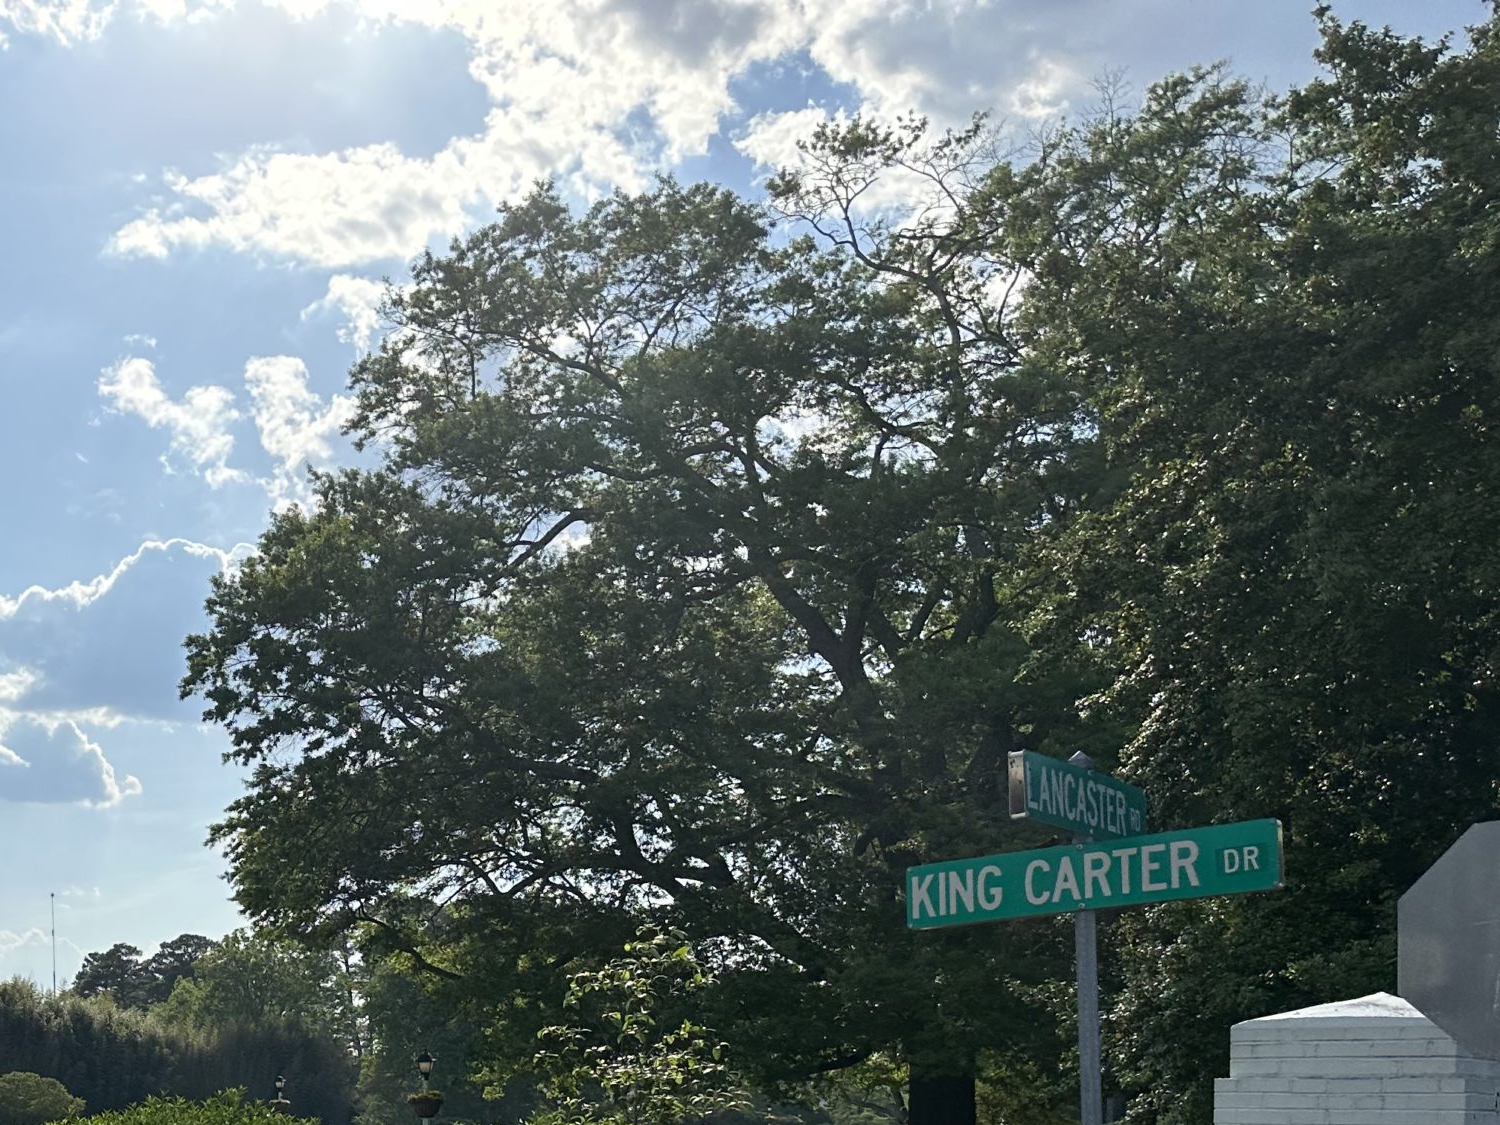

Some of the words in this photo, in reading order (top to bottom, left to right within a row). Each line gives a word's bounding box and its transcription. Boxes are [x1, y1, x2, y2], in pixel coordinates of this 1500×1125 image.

[1026, 761, 1127, 836] LANCASTER
[1130, 807, 1141, 832] RD
[911, 865, 1003, 920] KING
[1024, 840, 1200, 906] CARTER
[1223, 845, 1260, 874] DR
